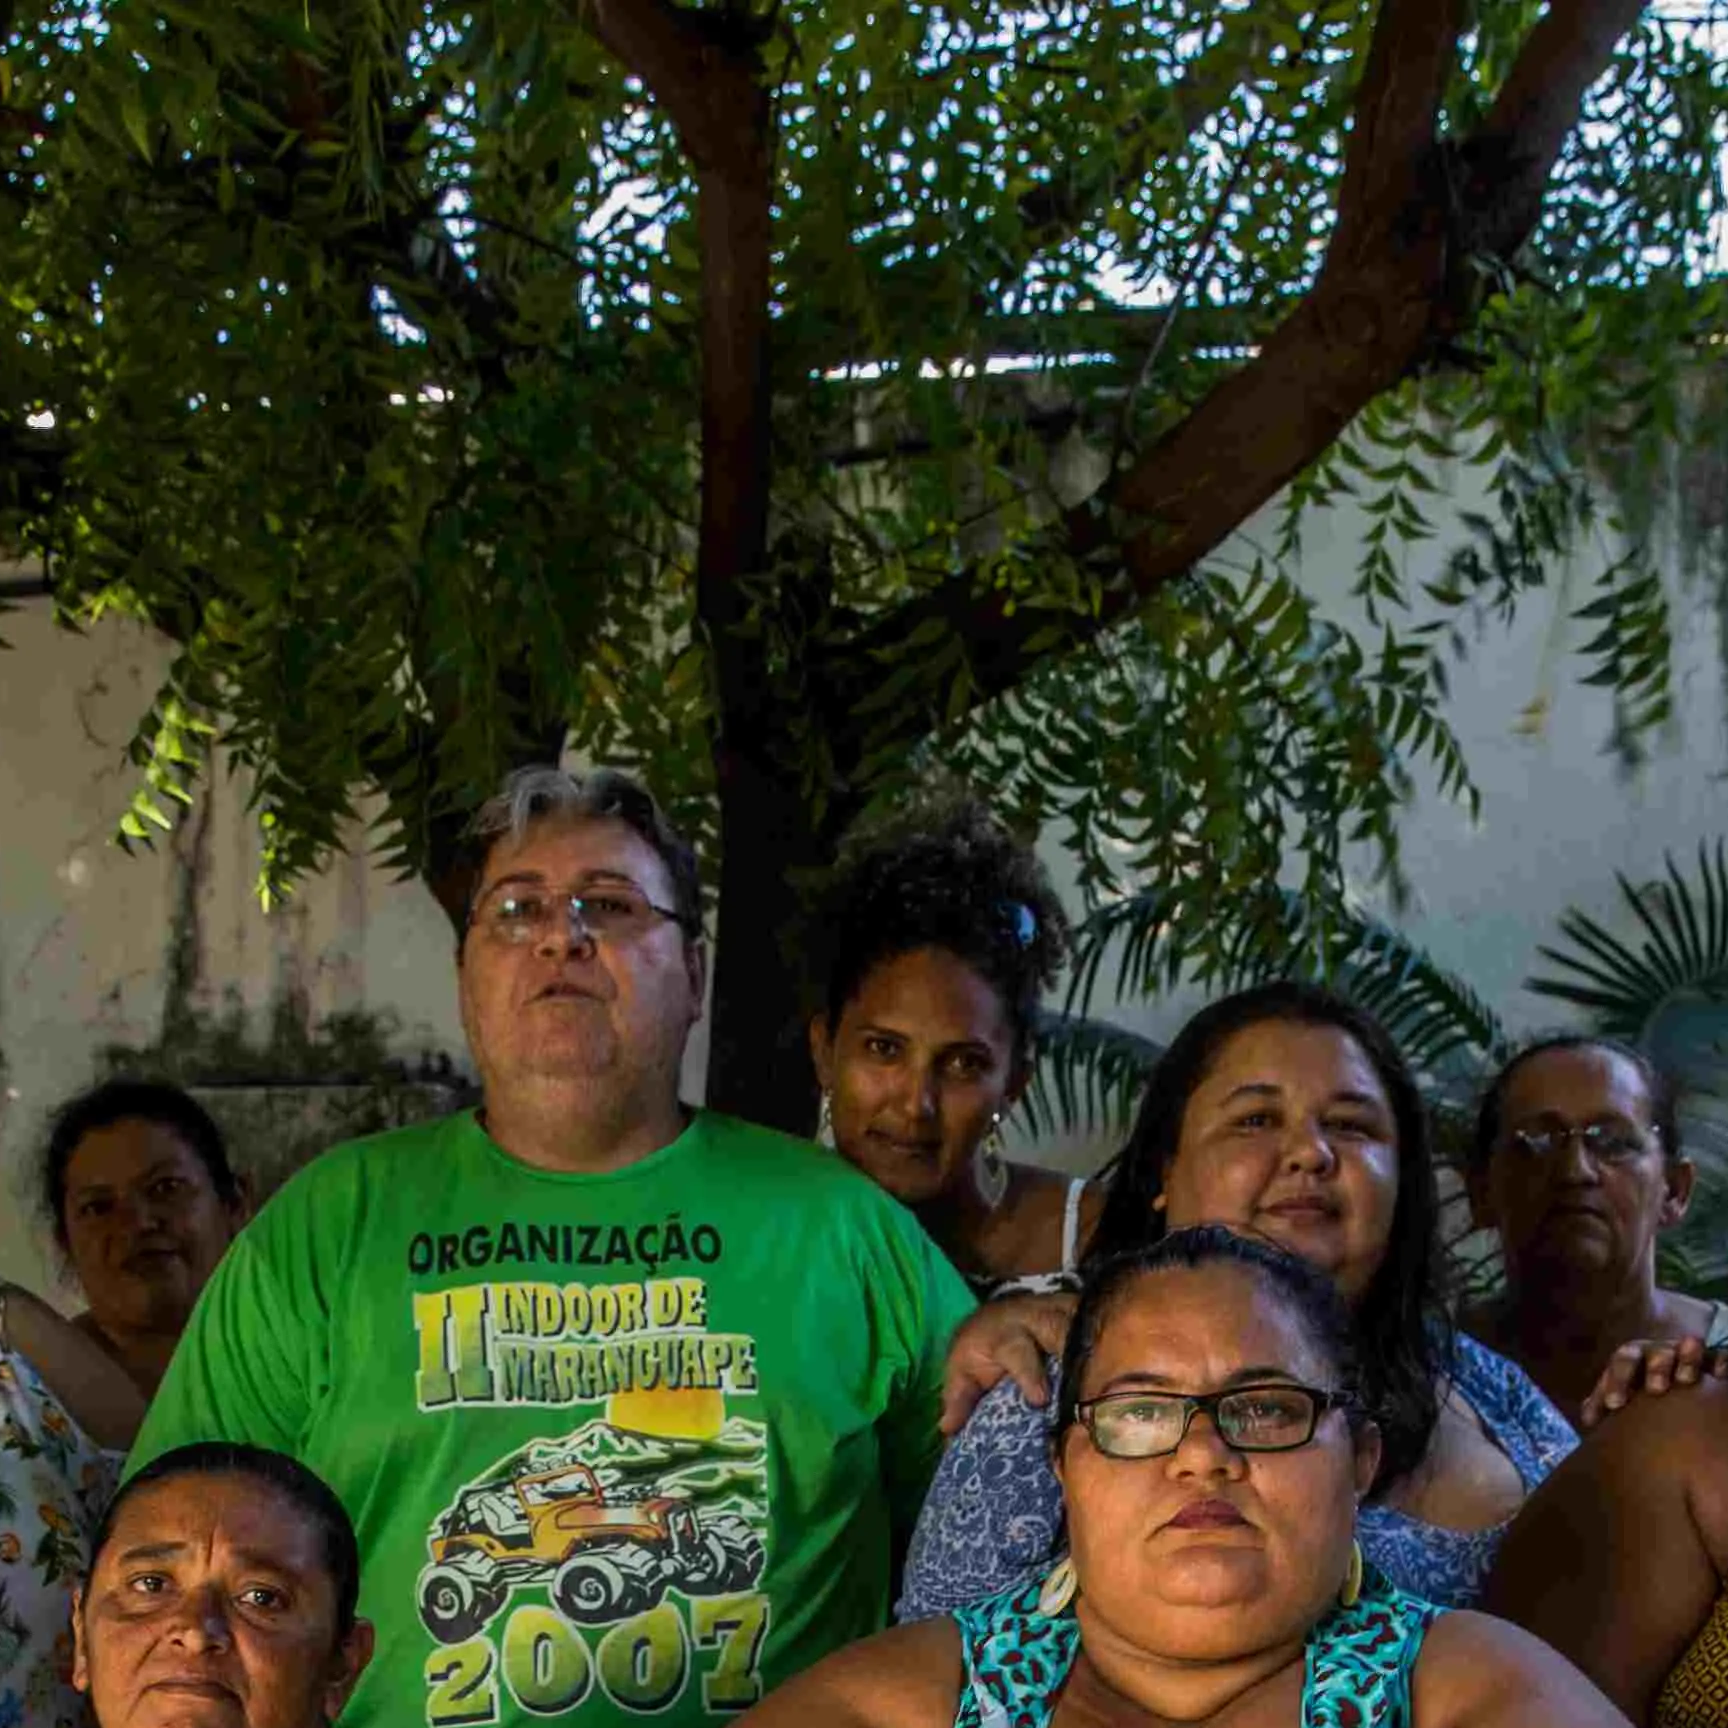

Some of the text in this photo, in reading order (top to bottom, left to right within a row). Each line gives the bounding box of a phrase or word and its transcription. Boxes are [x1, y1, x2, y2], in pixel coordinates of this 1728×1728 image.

[408, 1212, 722, 1277] ORGANIZAÇÃO
[414, 1278, 706, 1411] II INDOOR DE
[494, 1334, 758, 1403] MARANGUAPE
